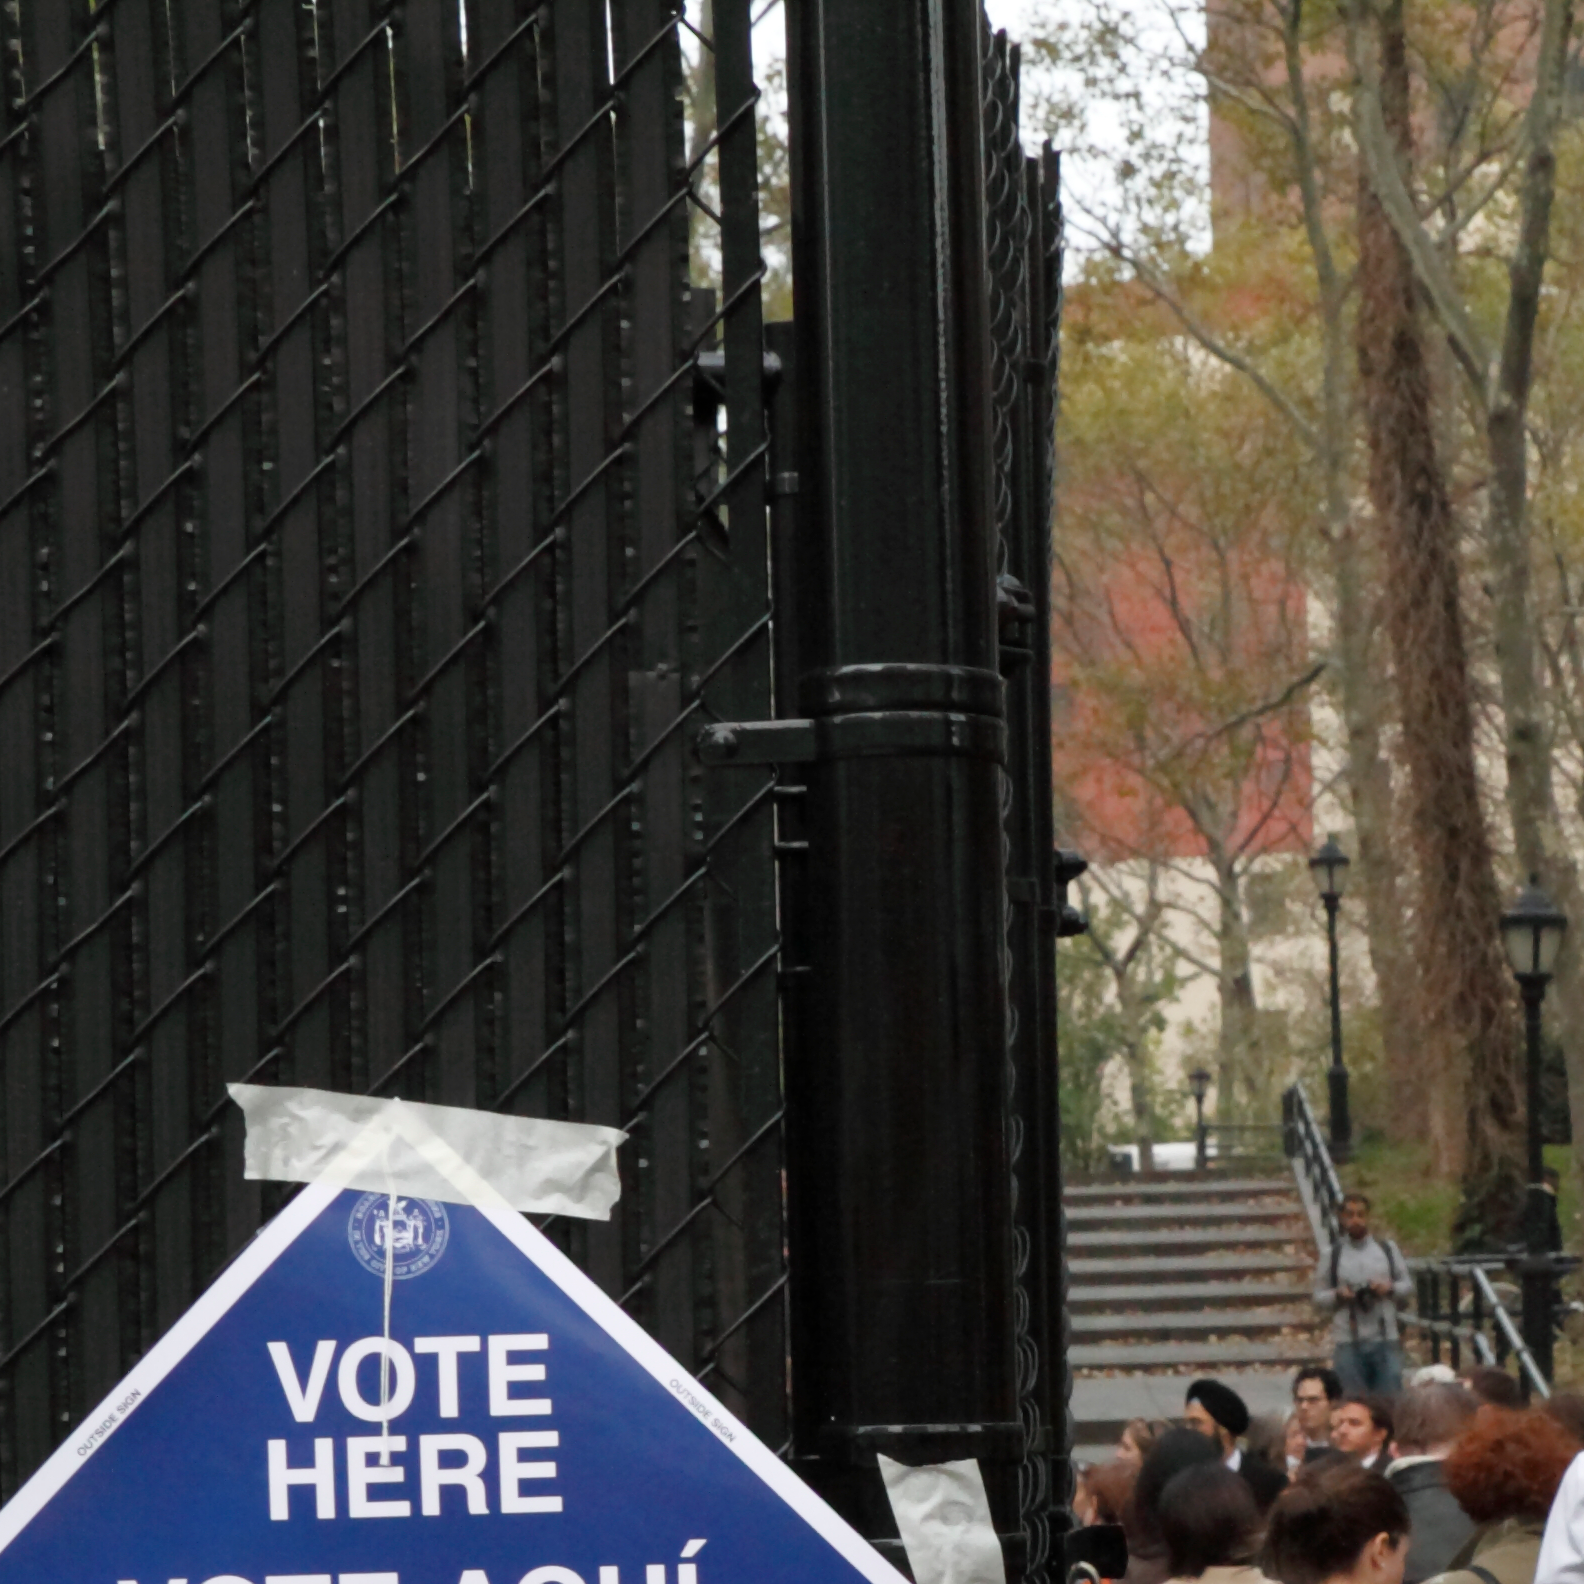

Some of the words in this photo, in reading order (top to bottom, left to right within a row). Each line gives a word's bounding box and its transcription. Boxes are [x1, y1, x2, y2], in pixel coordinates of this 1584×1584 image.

[266, 1333, 552, 1423] VOTE
[669, 1379, 713, 1420] OUTSIDE
[711, 1417, 738, 1443] SIGN
[76, 1412, 119, 1457] OUTSIDE
[116, 1387, 142, 1414] SIGN
[267, 1431, 563, 1521] HERE
